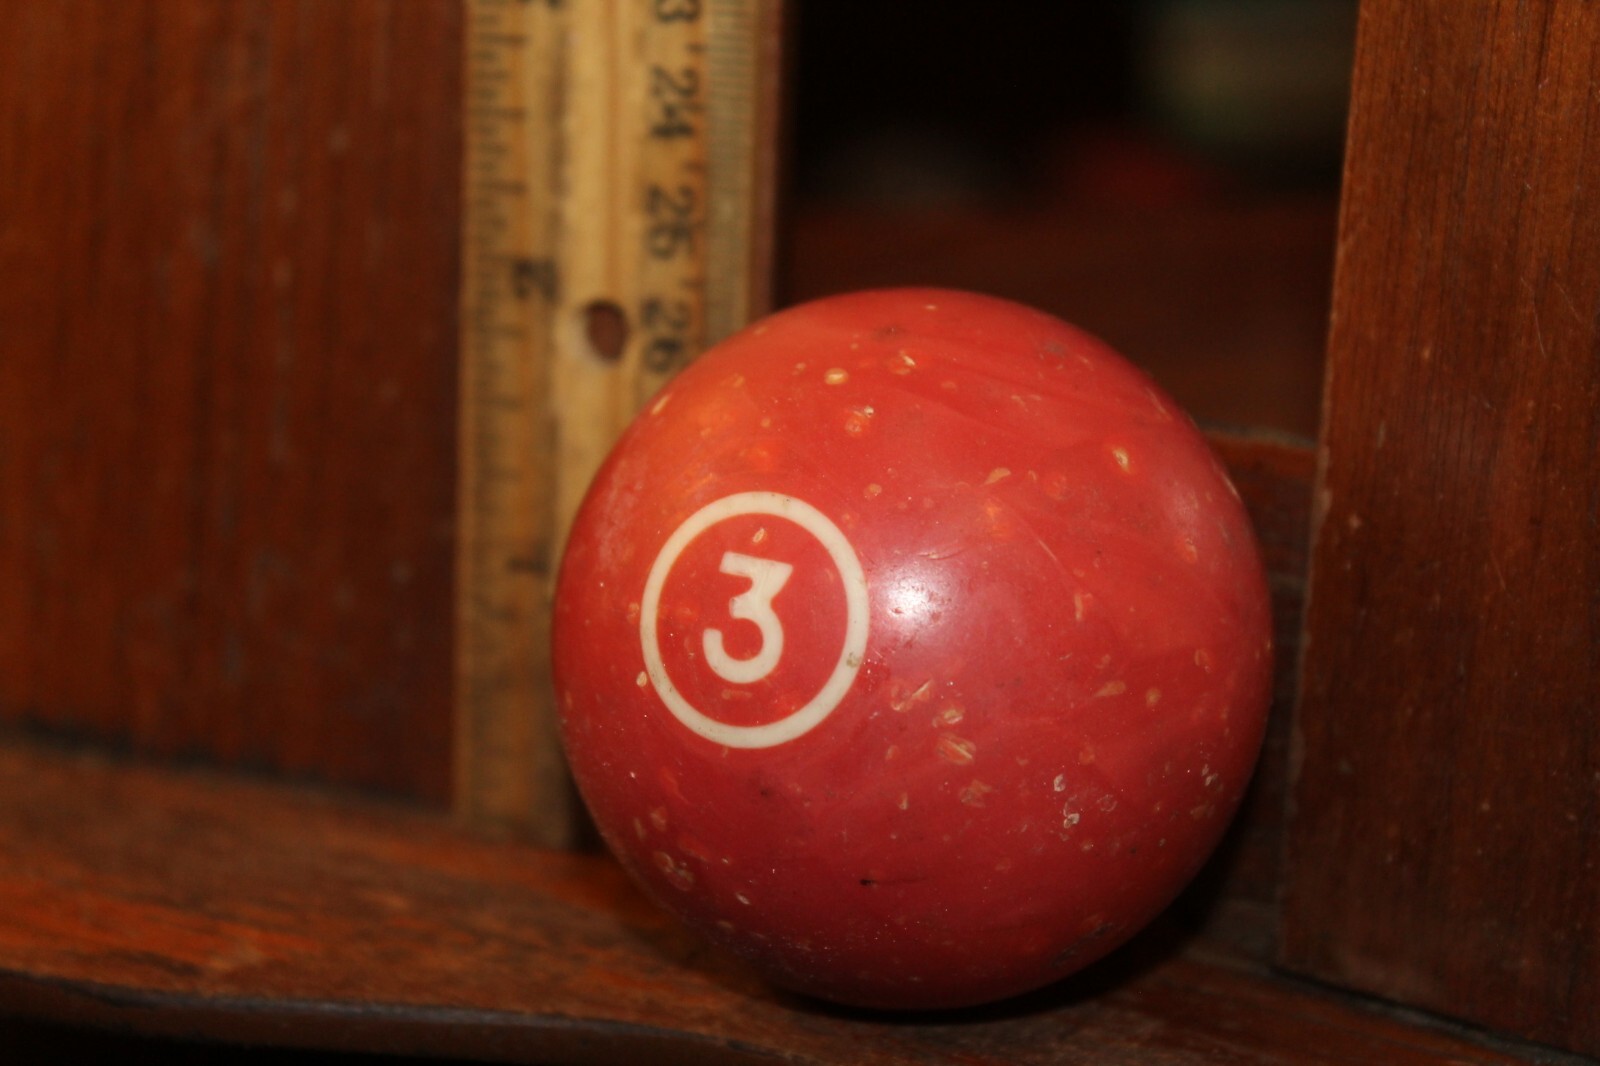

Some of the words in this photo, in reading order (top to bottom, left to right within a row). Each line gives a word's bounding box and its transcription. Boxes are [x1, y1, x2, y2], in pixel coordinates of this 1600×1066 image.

[650, 65, 697, 139] 24
[646, 184, 694, 261] 25
[642, 297, 690, 374] 26
[702, 551, 794, 684] 3
